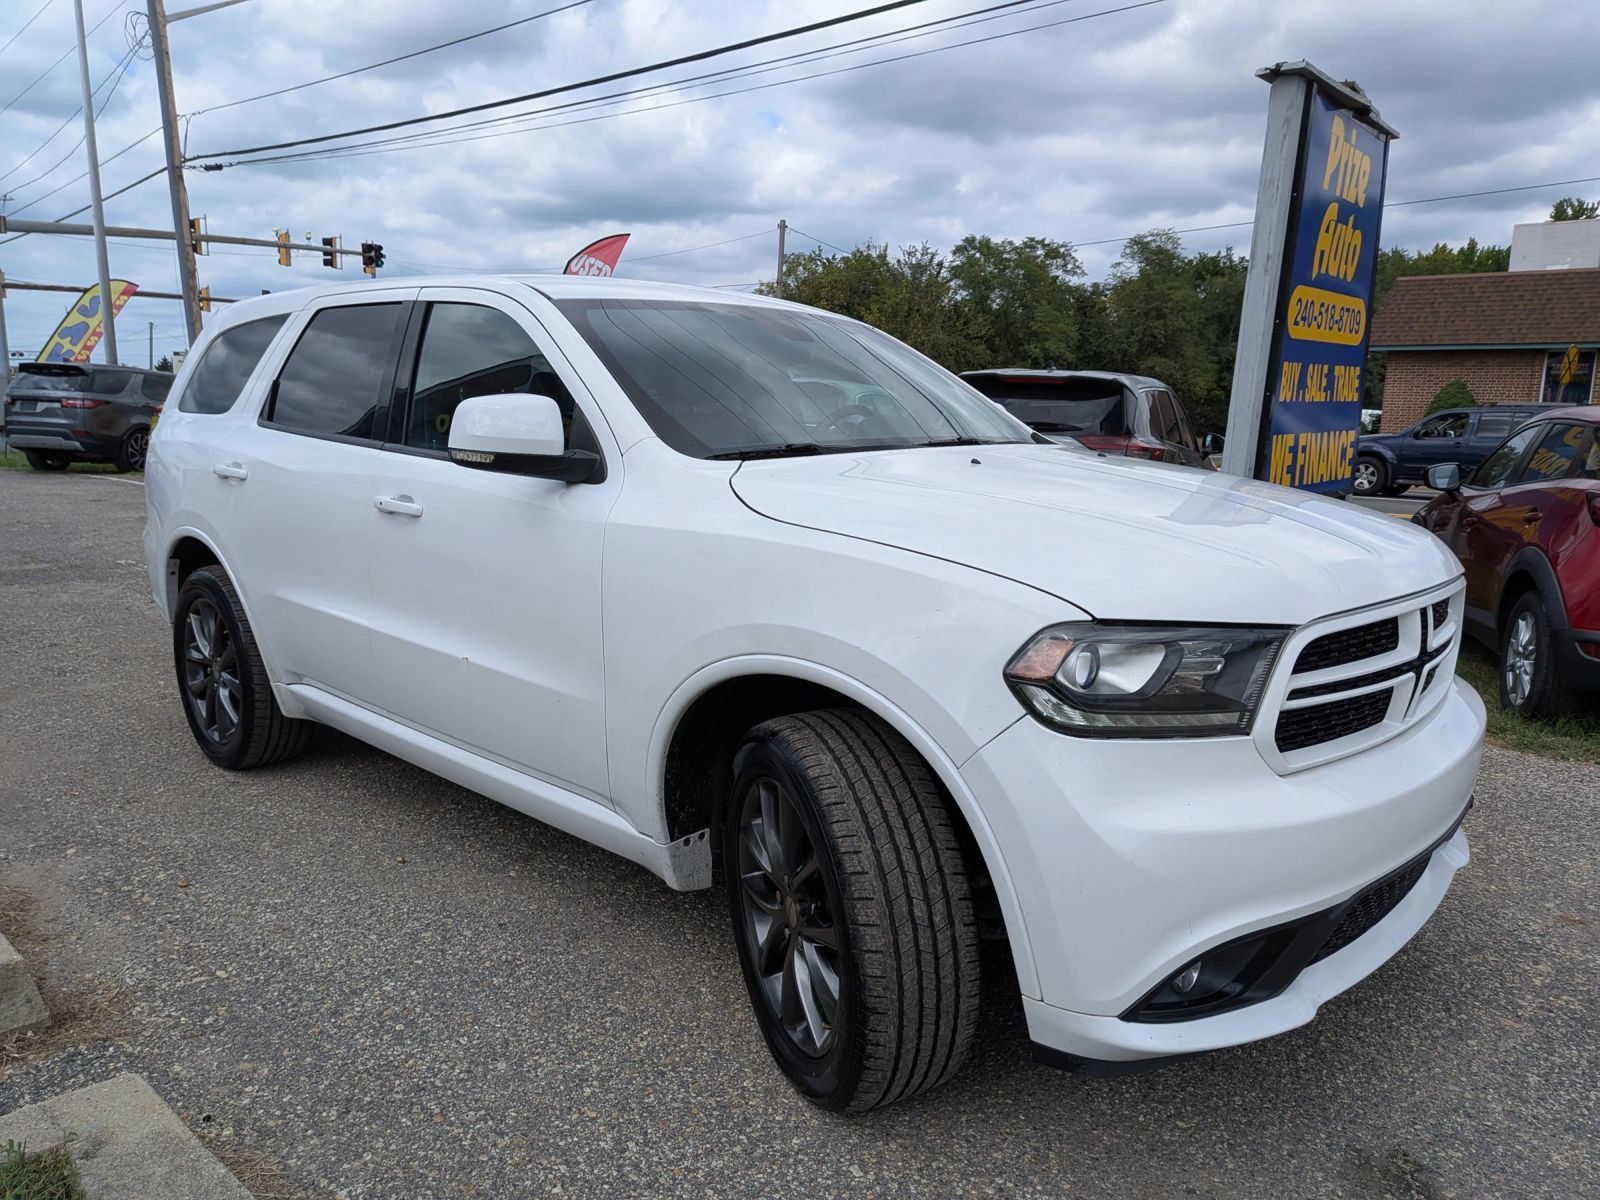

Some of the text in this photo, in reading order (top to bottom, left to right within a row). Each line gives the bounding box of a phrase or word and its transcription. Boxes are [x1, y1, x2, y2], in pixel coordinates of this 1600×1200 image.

[1323, 115, 1370, 208] Prize
[570, 253, 612, 277] USED
[1312, 203, 1362, 281] Auto
[1293, 297, 1361, 335] 240-518-8709
[1333, 365, 1360, 402] TRADE
[1269, 430, 1356, 487] WE FINANCE
